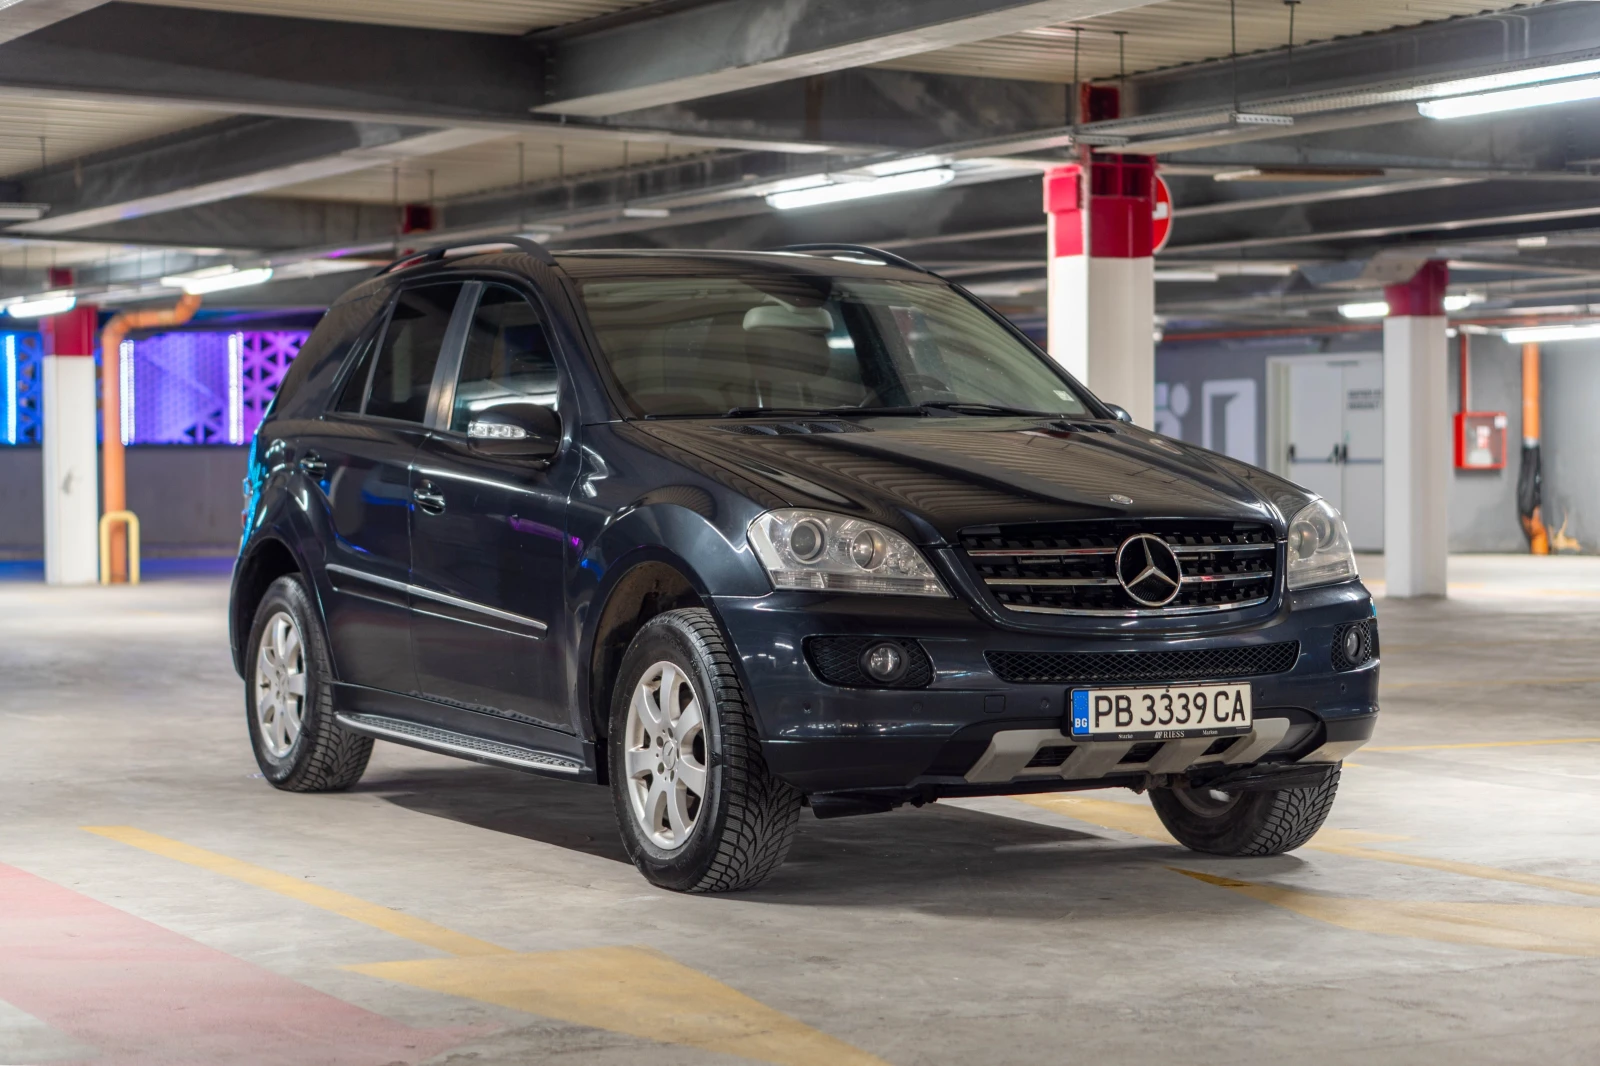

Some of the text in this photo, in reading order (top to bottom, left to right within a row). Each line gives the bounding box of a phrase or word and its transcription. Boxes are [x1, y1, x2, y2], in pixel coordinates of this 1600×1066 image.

[1095, 689, 1246, 728] PB 3339 CA
[1074, 717, 1088, 728] BG
[1163, 730, 1185, 739] RIESS
